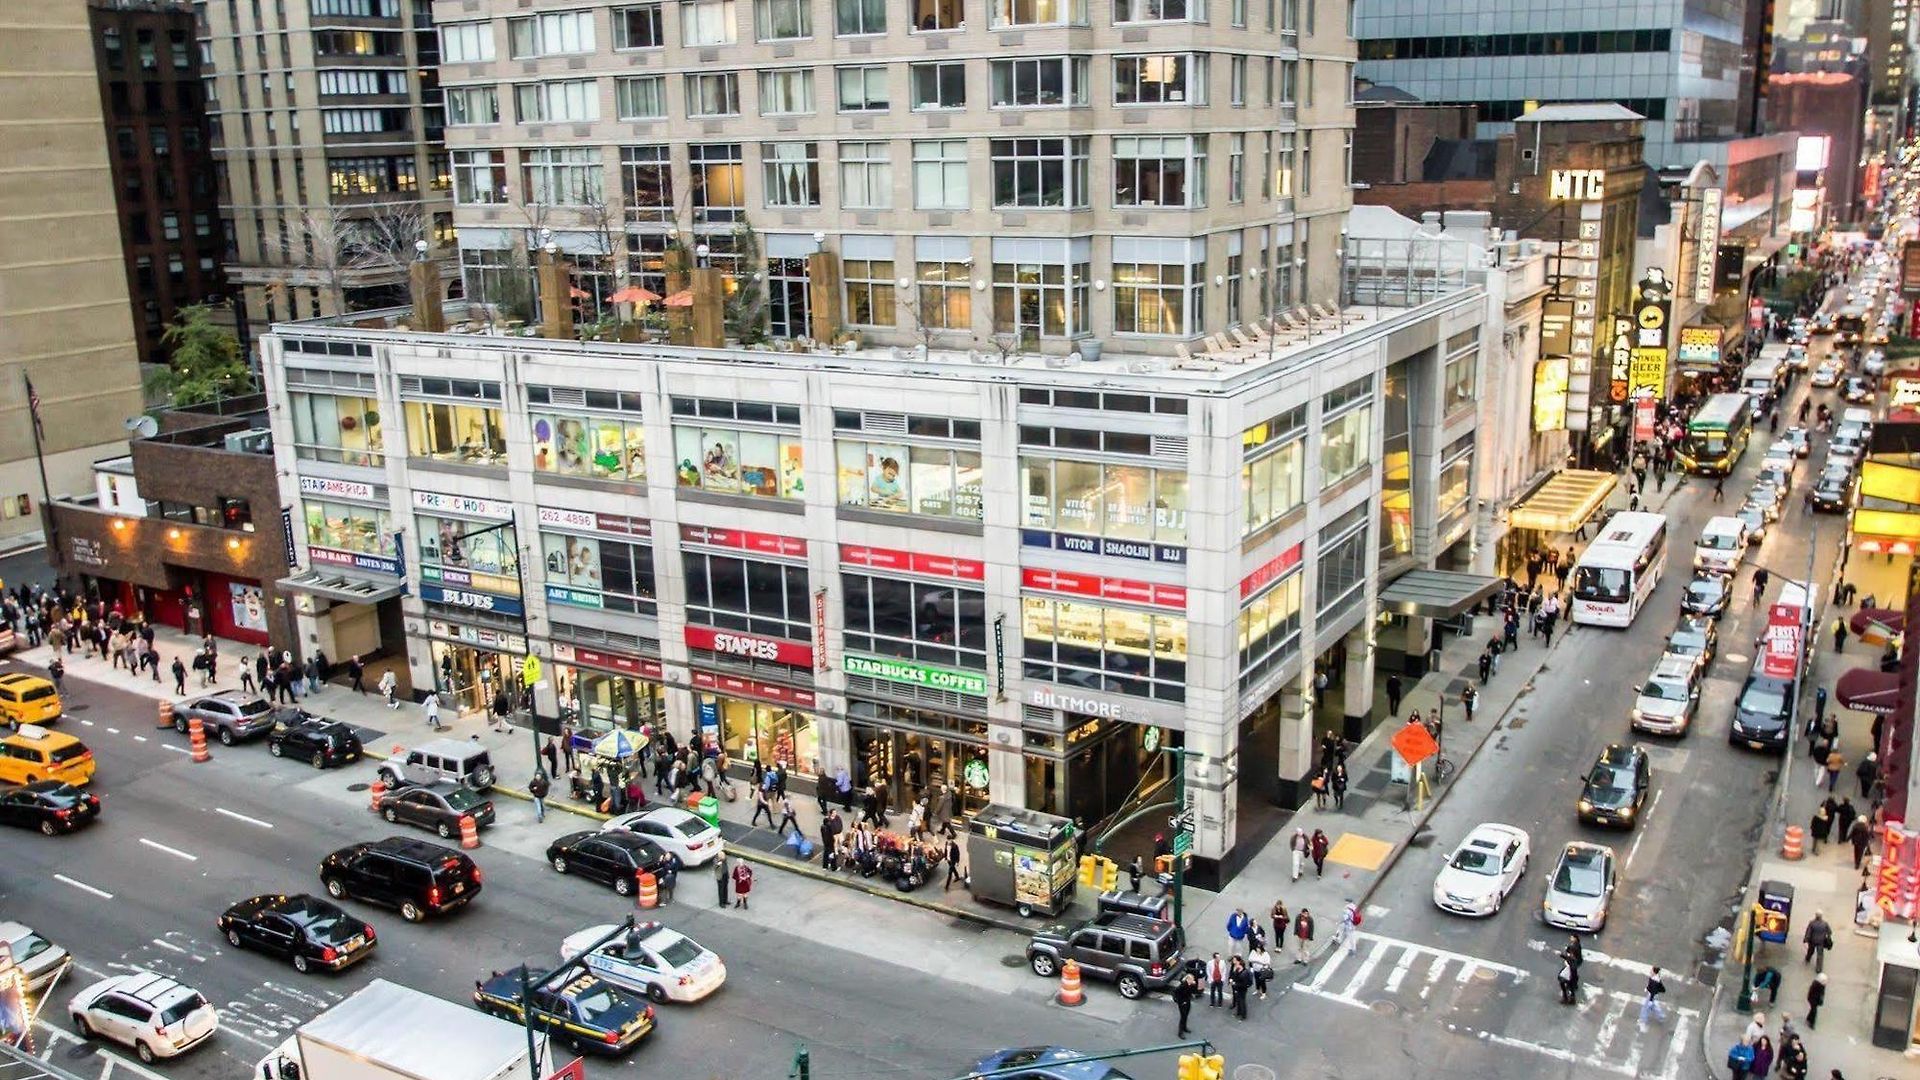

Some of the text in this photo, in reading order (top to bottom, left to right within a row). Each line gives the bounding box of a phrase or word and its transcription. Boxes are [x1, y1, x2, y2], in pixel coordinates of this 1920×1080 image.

[1550, 169, 1605, 200] MTC
[1573, 222, 1599, 373] FRIEDMAN
[1612, 319, 1632, 380] PARK
[1156, 507, 1187, 529] BJJ
[1064, 537, 1181, 561] VITOR SHAOLIN BJJ
[442, 589, 495, 609] BLUES
[815, 597, 827, 664] STAPLES
[713, 633, 778, 660] STAPLES
[847, 657, 985, 692] STARBUCKS COFFEE
[1033, 690, 1121, 719] BILTMORE
